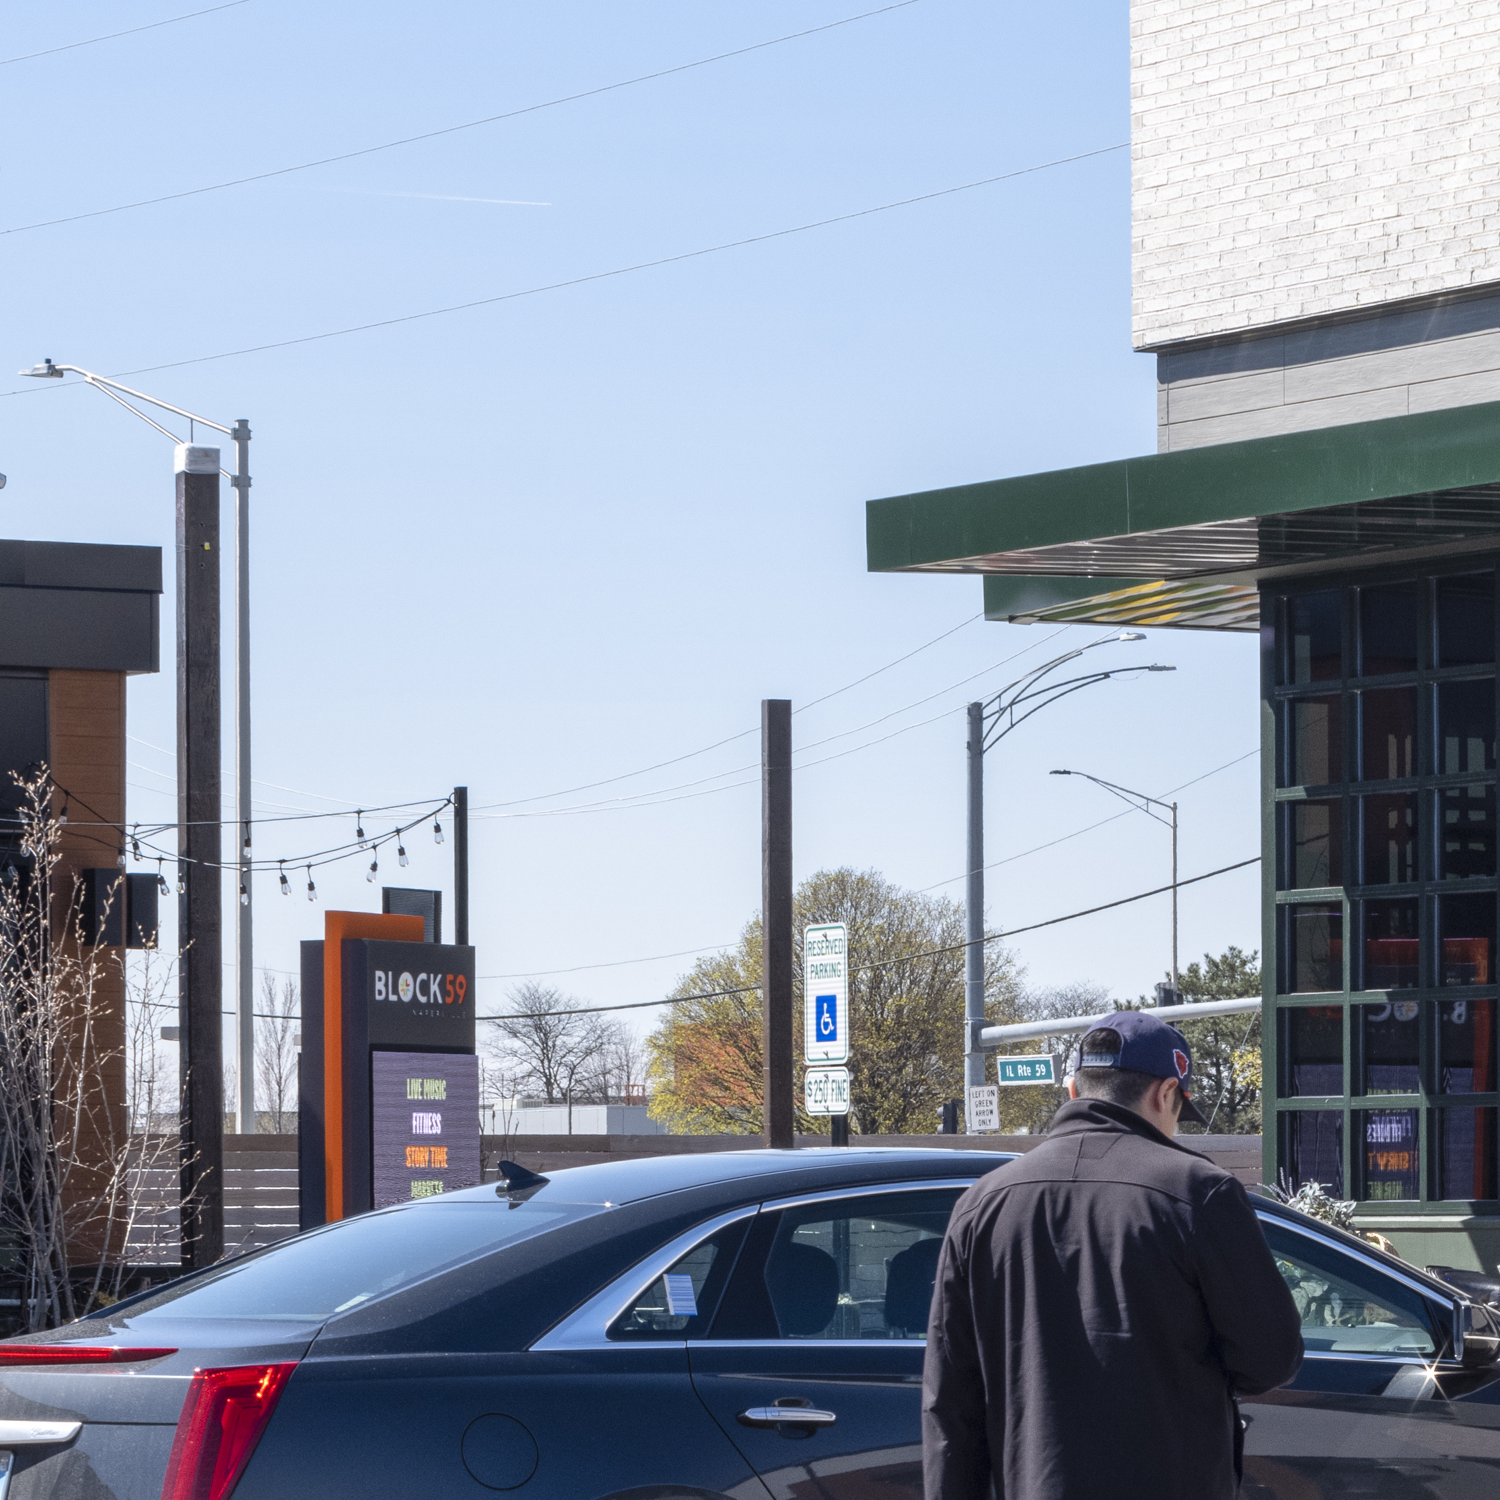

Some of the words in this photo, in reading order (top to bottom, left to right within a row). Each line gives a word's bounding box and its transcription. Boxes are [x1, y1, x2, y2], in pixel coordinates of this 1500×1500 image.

[807, 938, 843, 956] RESERVED
[810, 962, 841, 980] PARKING
[1006, 1065, 1015, 1077] IL
[1018, 1064, 1032, 1077] Rte
[1036, 1064, 1046, 1077] 59
[406, 1078, 422, 1099] LIVE
[424, 1079, 446, 1100] MUSIC
[831, 1079, 847, 1103] FINE
[972, 1090, 985, 1099] LEFT
[987, 1089, 995, 1098] ON
[975, 1099, 993, 1108] GREEN
[975, 1109, 994, 1117] ARROW
[412, 1112, 441, 1134] FITNESS
[978, 1119, 991, 1127] ONLY
[406, 1145, 429, 1168] STORY
[430, 1145, 448, 1168] TIME
